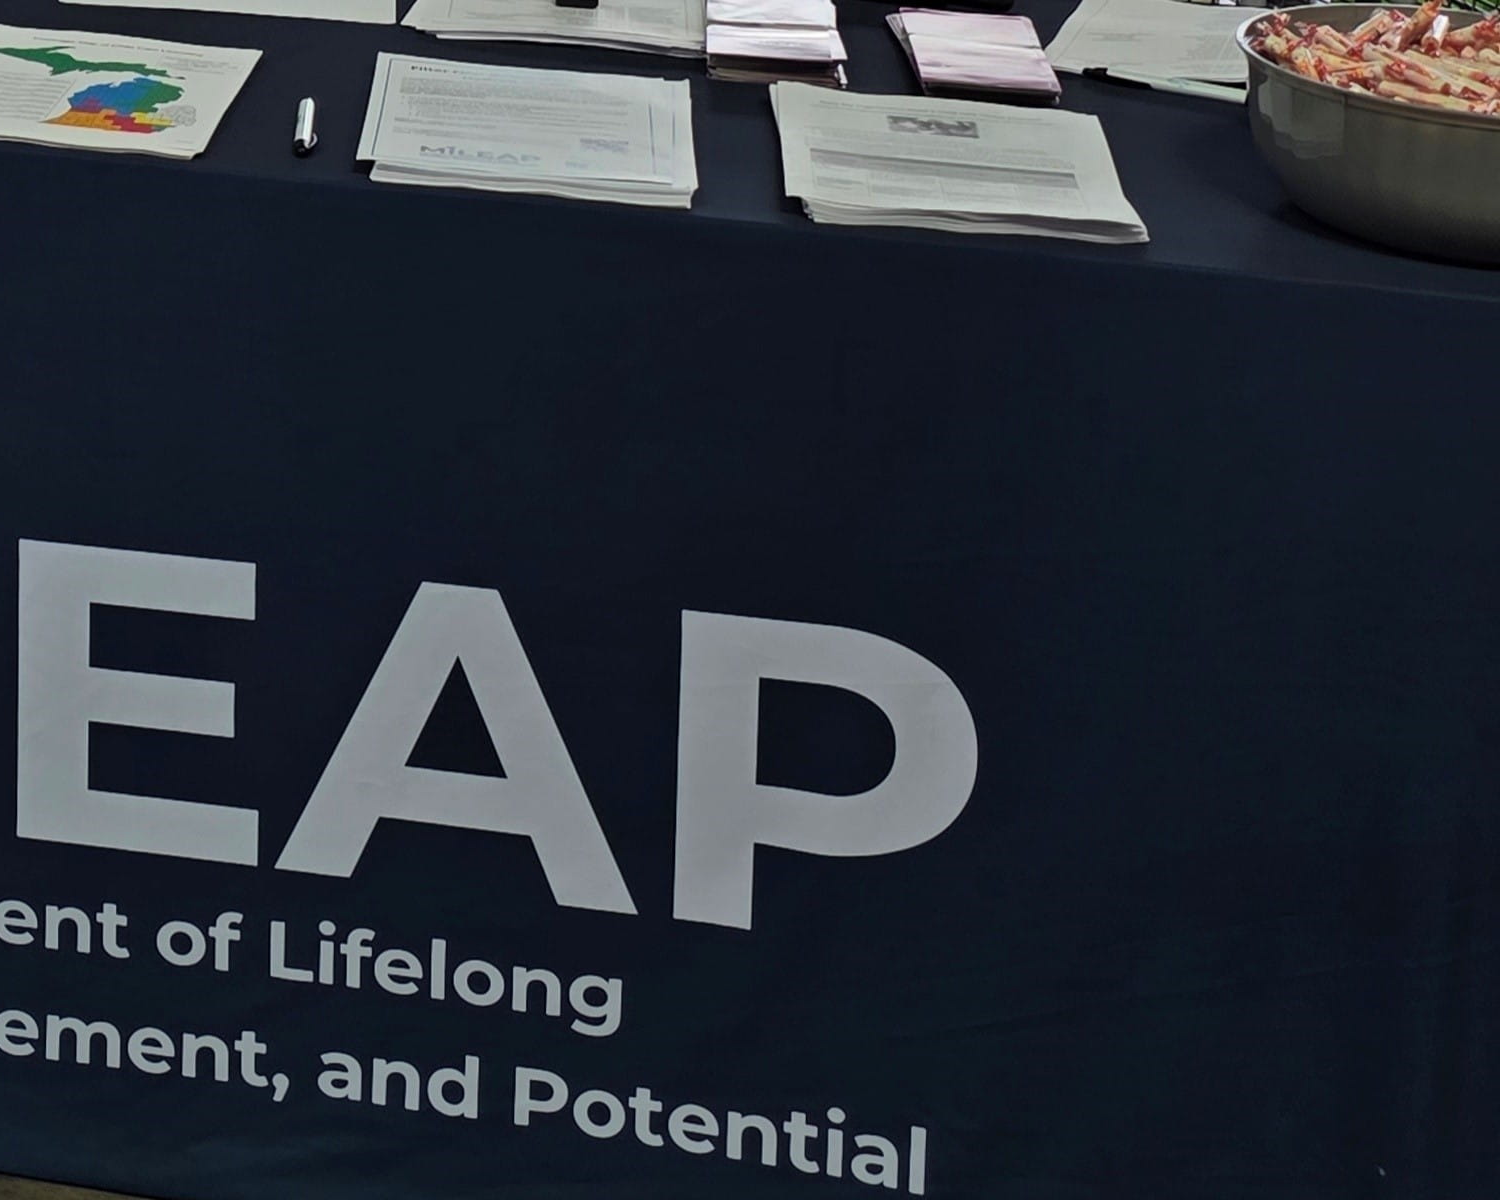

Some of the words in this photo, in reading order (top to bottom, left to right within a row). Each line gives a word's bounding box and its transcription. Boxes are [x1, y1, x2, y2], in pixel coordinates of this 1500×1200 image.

[157, 912, 242, 971] of
[270, 921, 623, 1037] Lifelong
[317, 1052, 480, 1119] and
[515, 1066, 927, 1195] Potential
